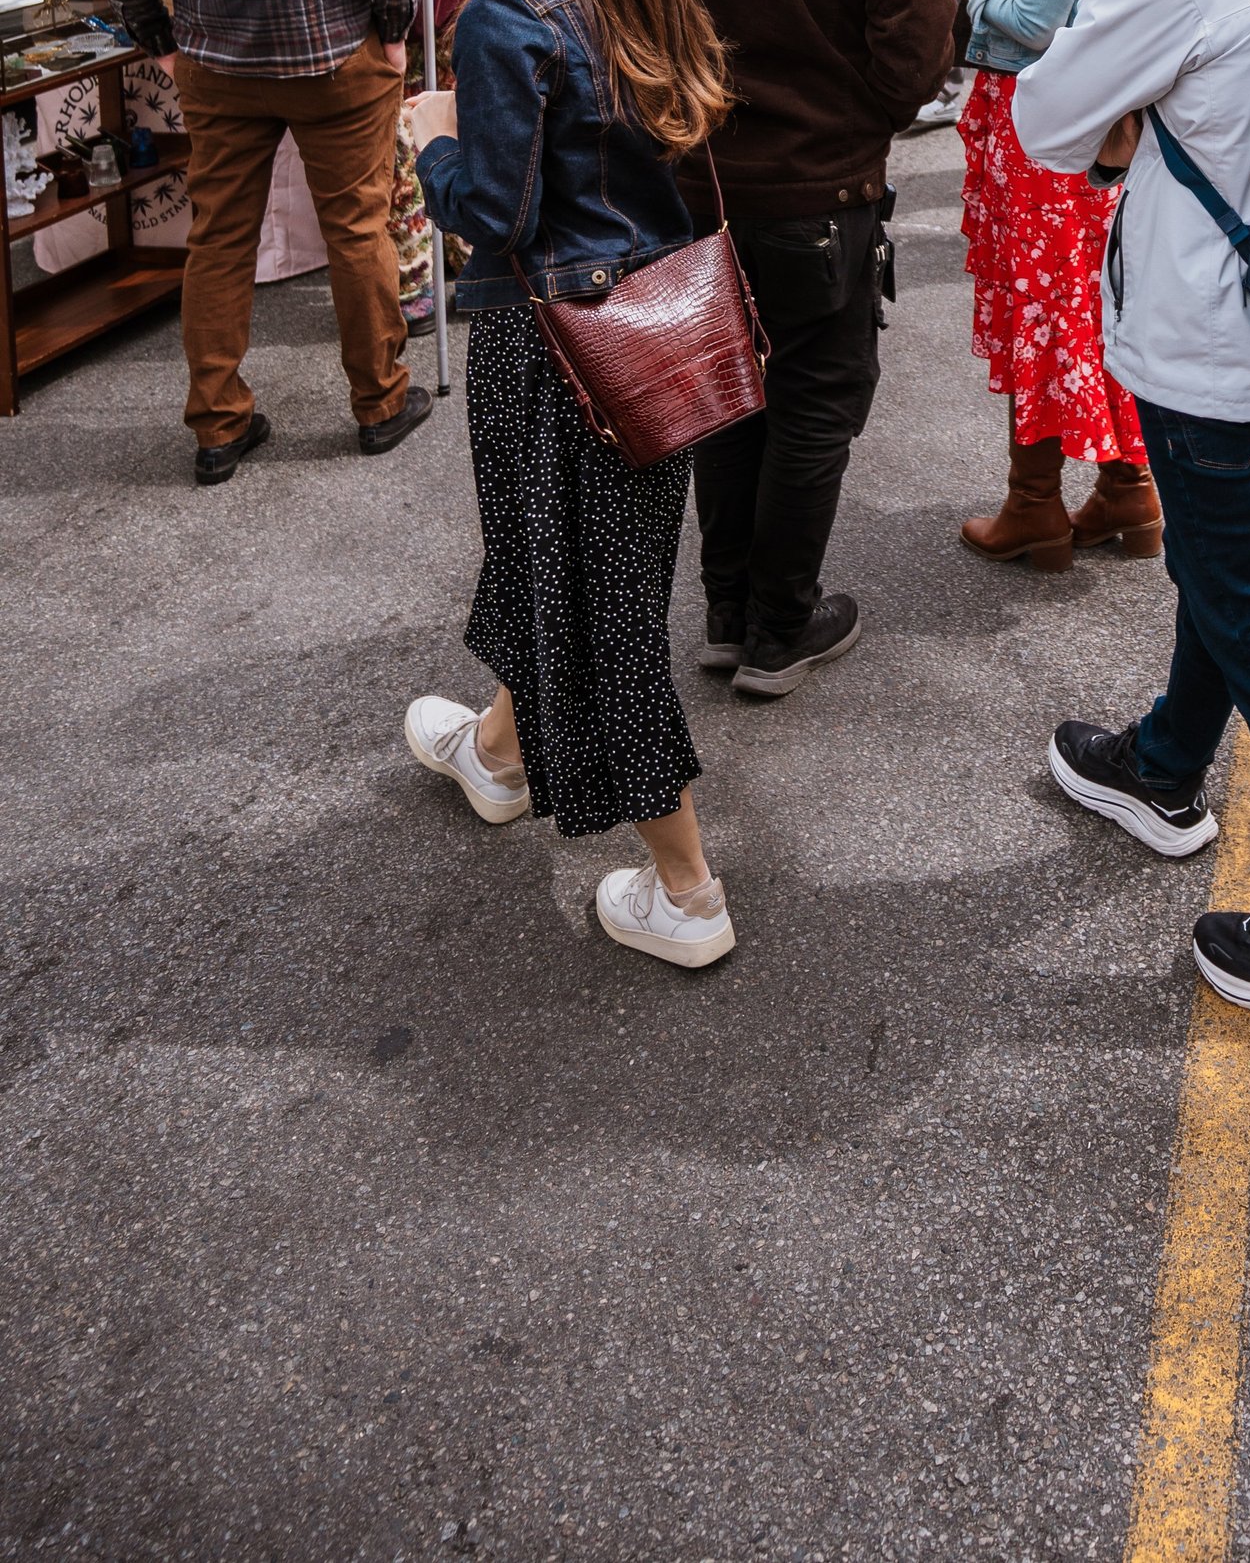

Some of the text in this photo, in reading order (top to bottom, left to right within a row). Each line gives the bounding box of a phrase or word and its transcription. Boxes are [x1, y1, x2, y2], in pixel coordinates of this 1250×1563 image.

[124, 63, 173, 90] LAND
[133, 216, 159, 231] OLD
[161, 192, 190, 223] STAN
